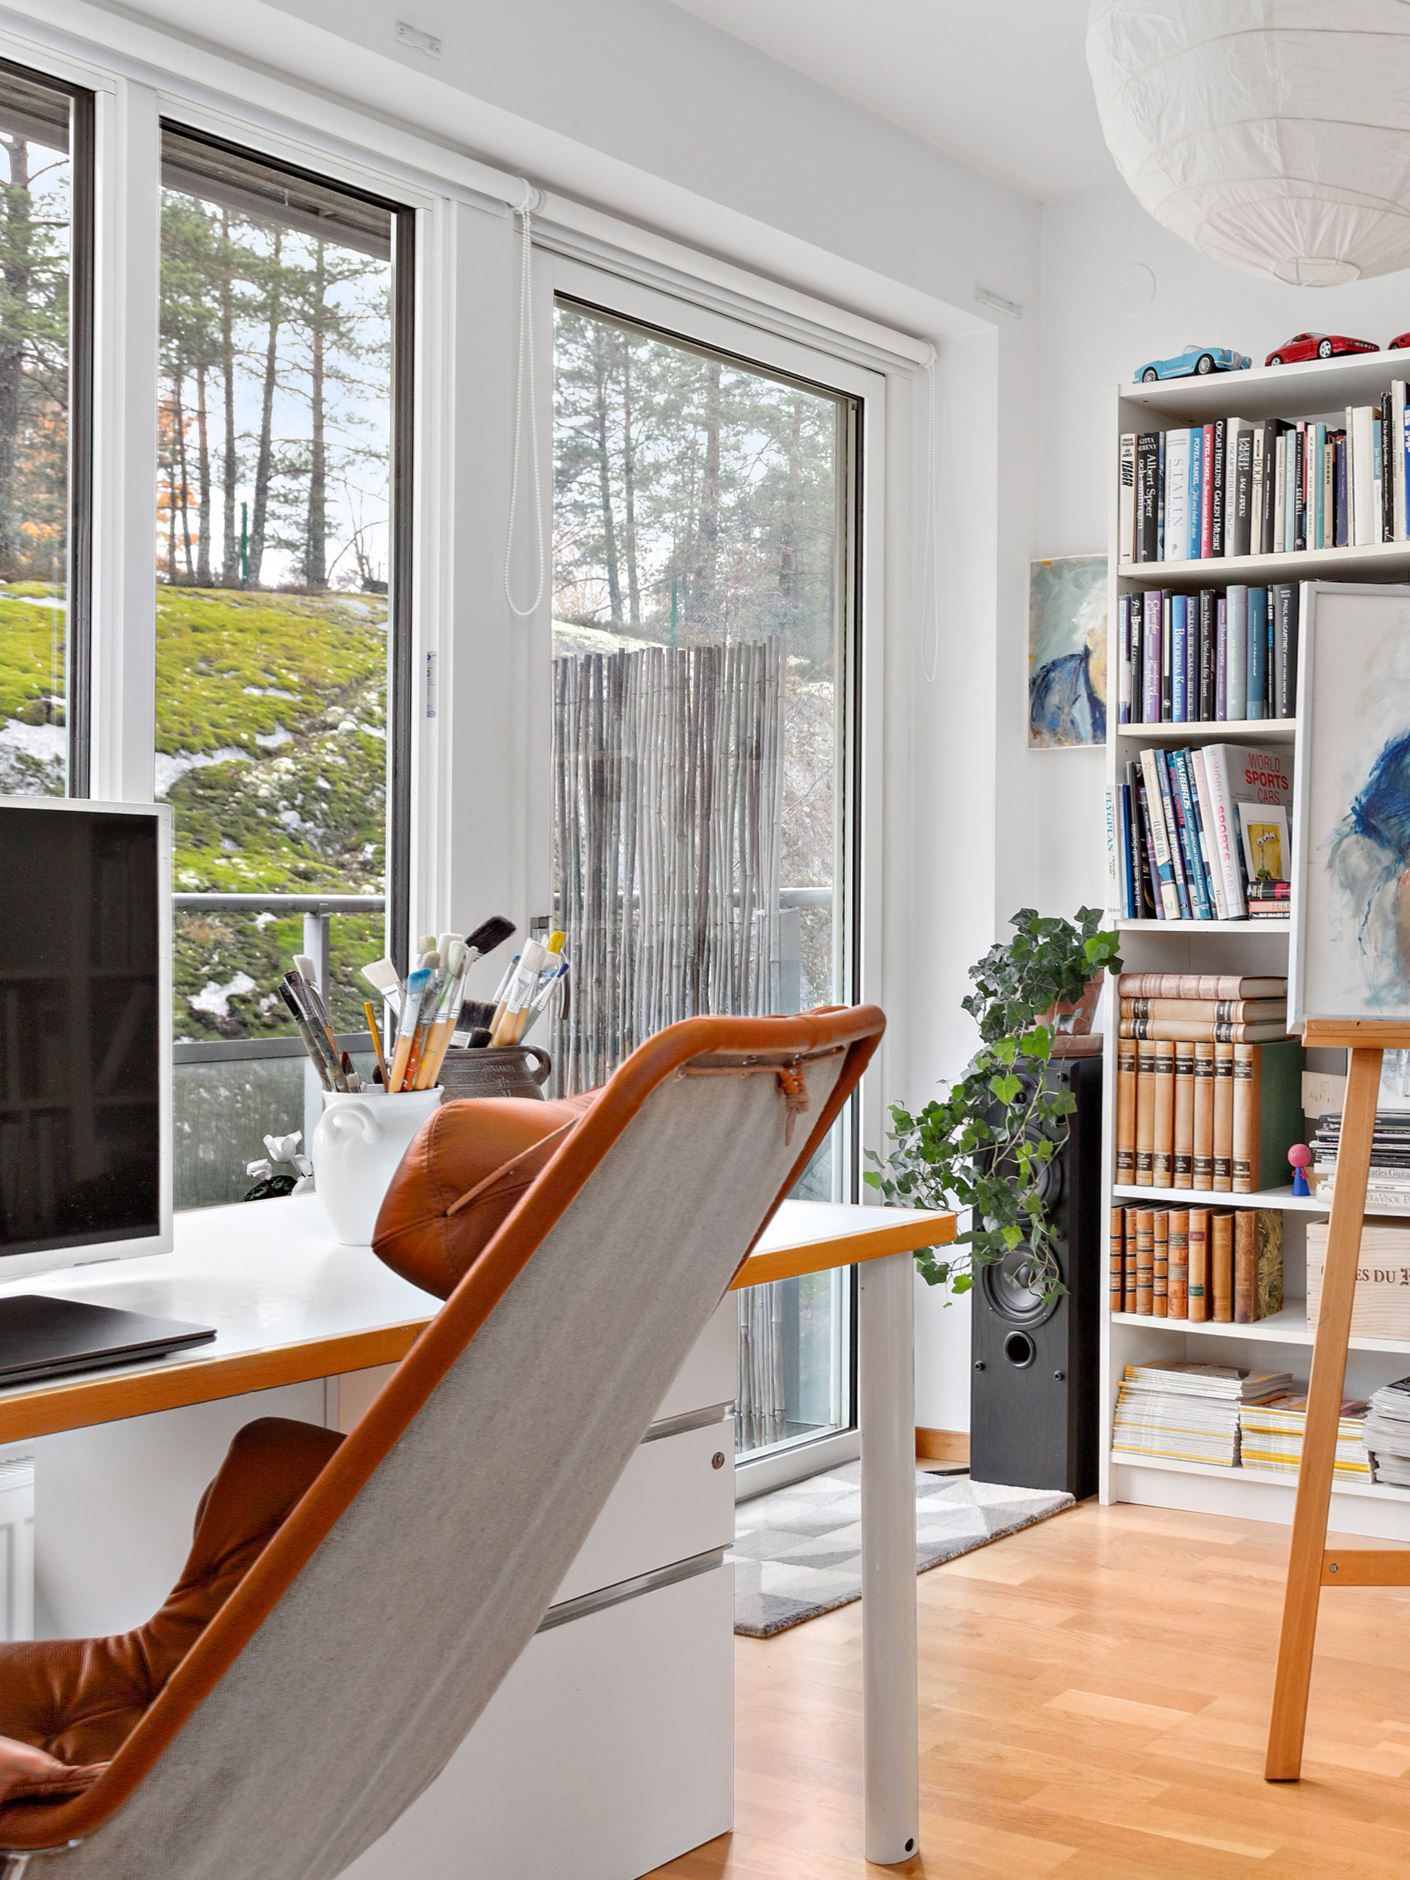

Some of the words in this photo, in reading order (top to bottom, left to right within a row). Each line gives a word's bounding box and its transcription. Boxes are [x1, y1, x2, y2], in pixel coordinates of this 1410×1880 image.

[1215, 420, 1224, 449] OSCAR
[1121, 460, 1134, 487] YEAGER
[1146, 454, 1156, 486] Albert
[1214, 449, 1223, 487] HEDLUND
[1144, 488, 1156, 518] Speer
[1172, 458, 1186, 527] STALIN
[1214, 490, 1222, 518] GALEN
[1213, 523, 1221, 551] MUSIK!
[1175, 628, 1185, 674] BRÖDERNA
[1175, 676, 1185, 715] KREUGER
[1248, 752, 1281, 772] WORLD
[1177, 758, 1192, 809] WARBIRDS
[1245, 769, 1289, 790] SPORTS
[1257, 788, 1281, 805] CARS
[1106, 792, 1114, 852] FLYGPLAN
[1216, 806, 1231, 861] SPORTS
[1373, 1269, 1396, 1284] DU
